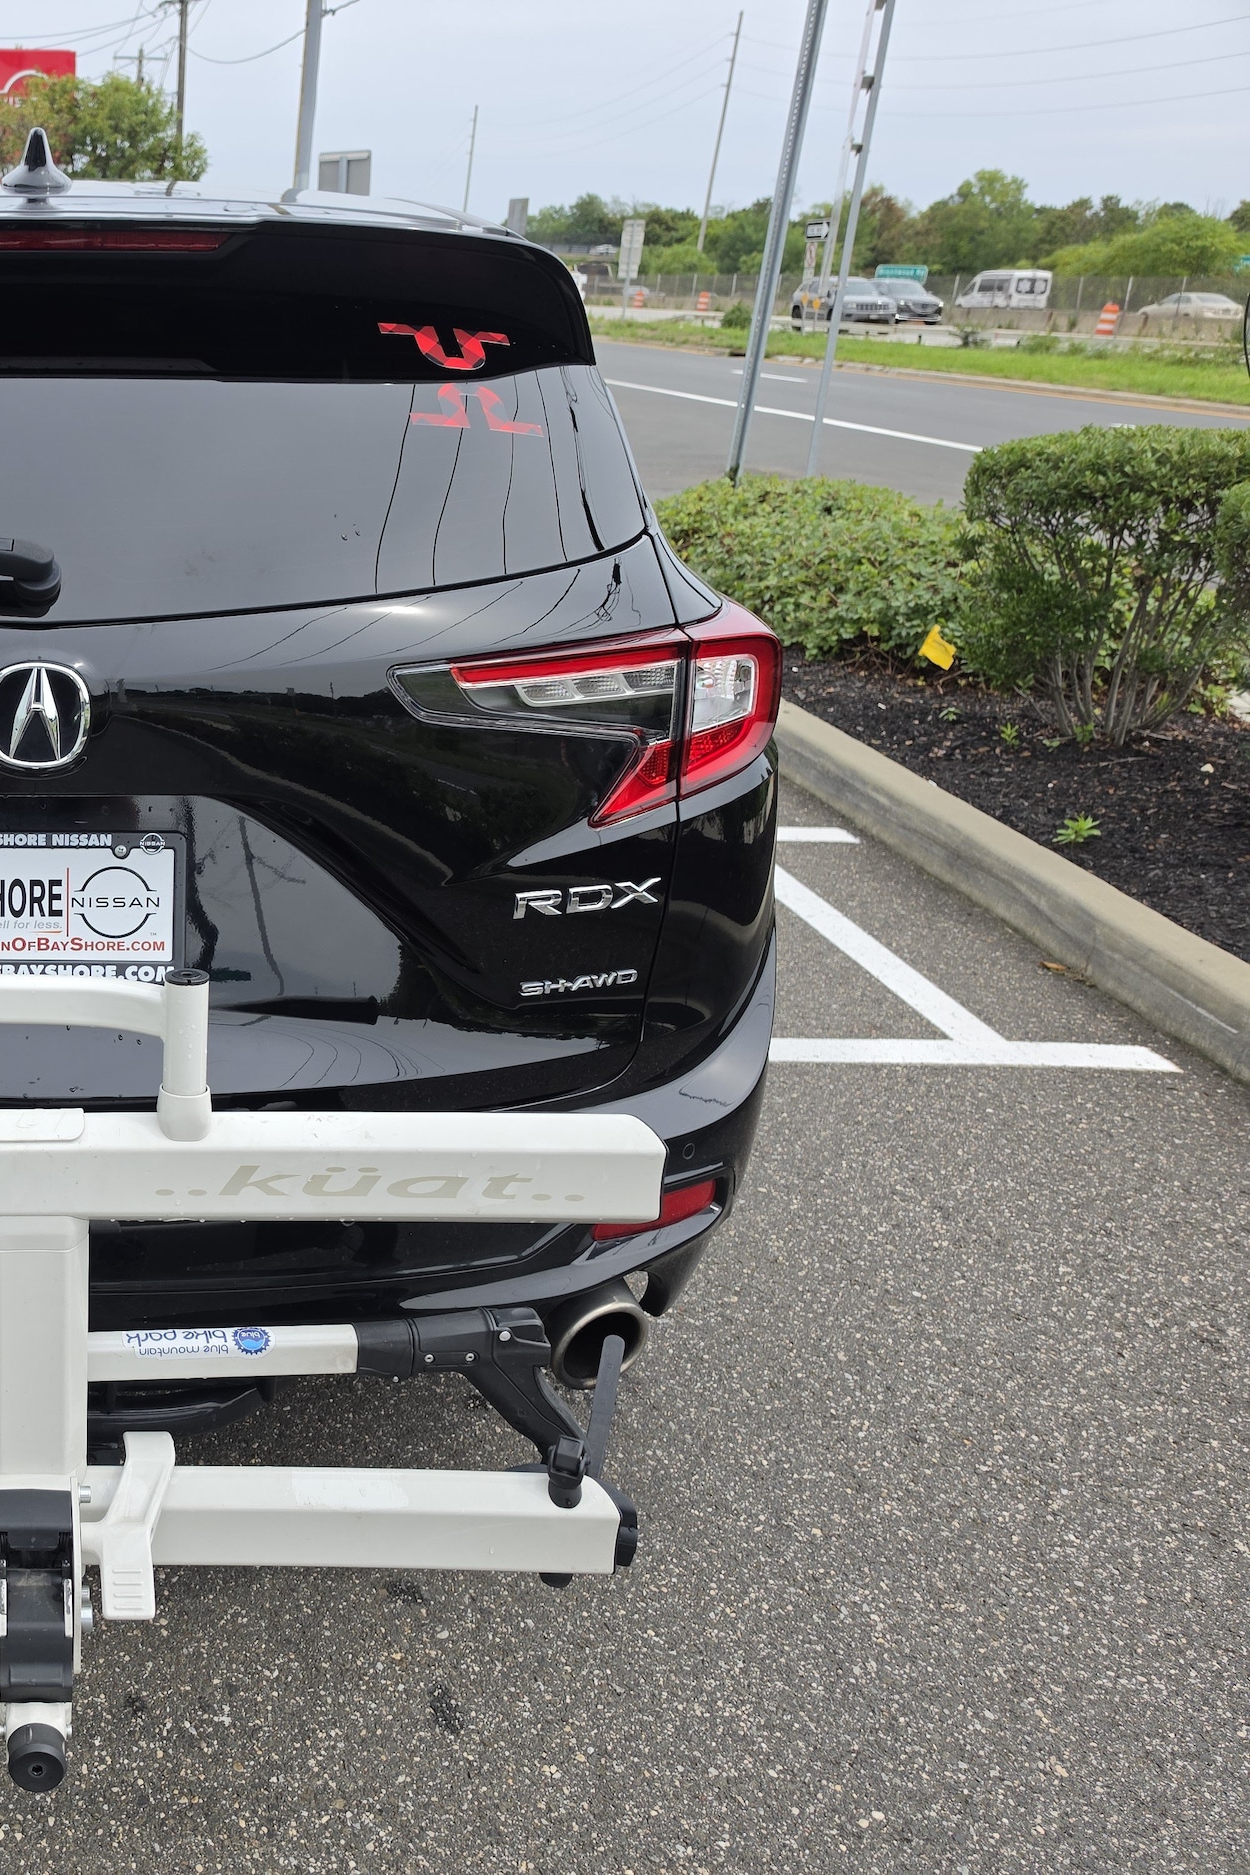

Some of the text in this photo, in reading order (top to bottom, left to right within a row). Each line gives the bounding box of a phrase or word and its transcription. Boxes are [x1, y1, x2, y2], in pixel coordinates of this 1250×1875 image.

[52, 834, 112, 846] NISSAN
[71, 897, 160, 908] NISSAN
[512, 877, 662, 920] RDX
[13, 920, 30, 929] for
[34, 920, 63, 929] less.
[126, 1329, 228, 1347] bike park
[240, 1331, 261, 1339] blue
[139, 1344, 229, 1357] blue mountain
